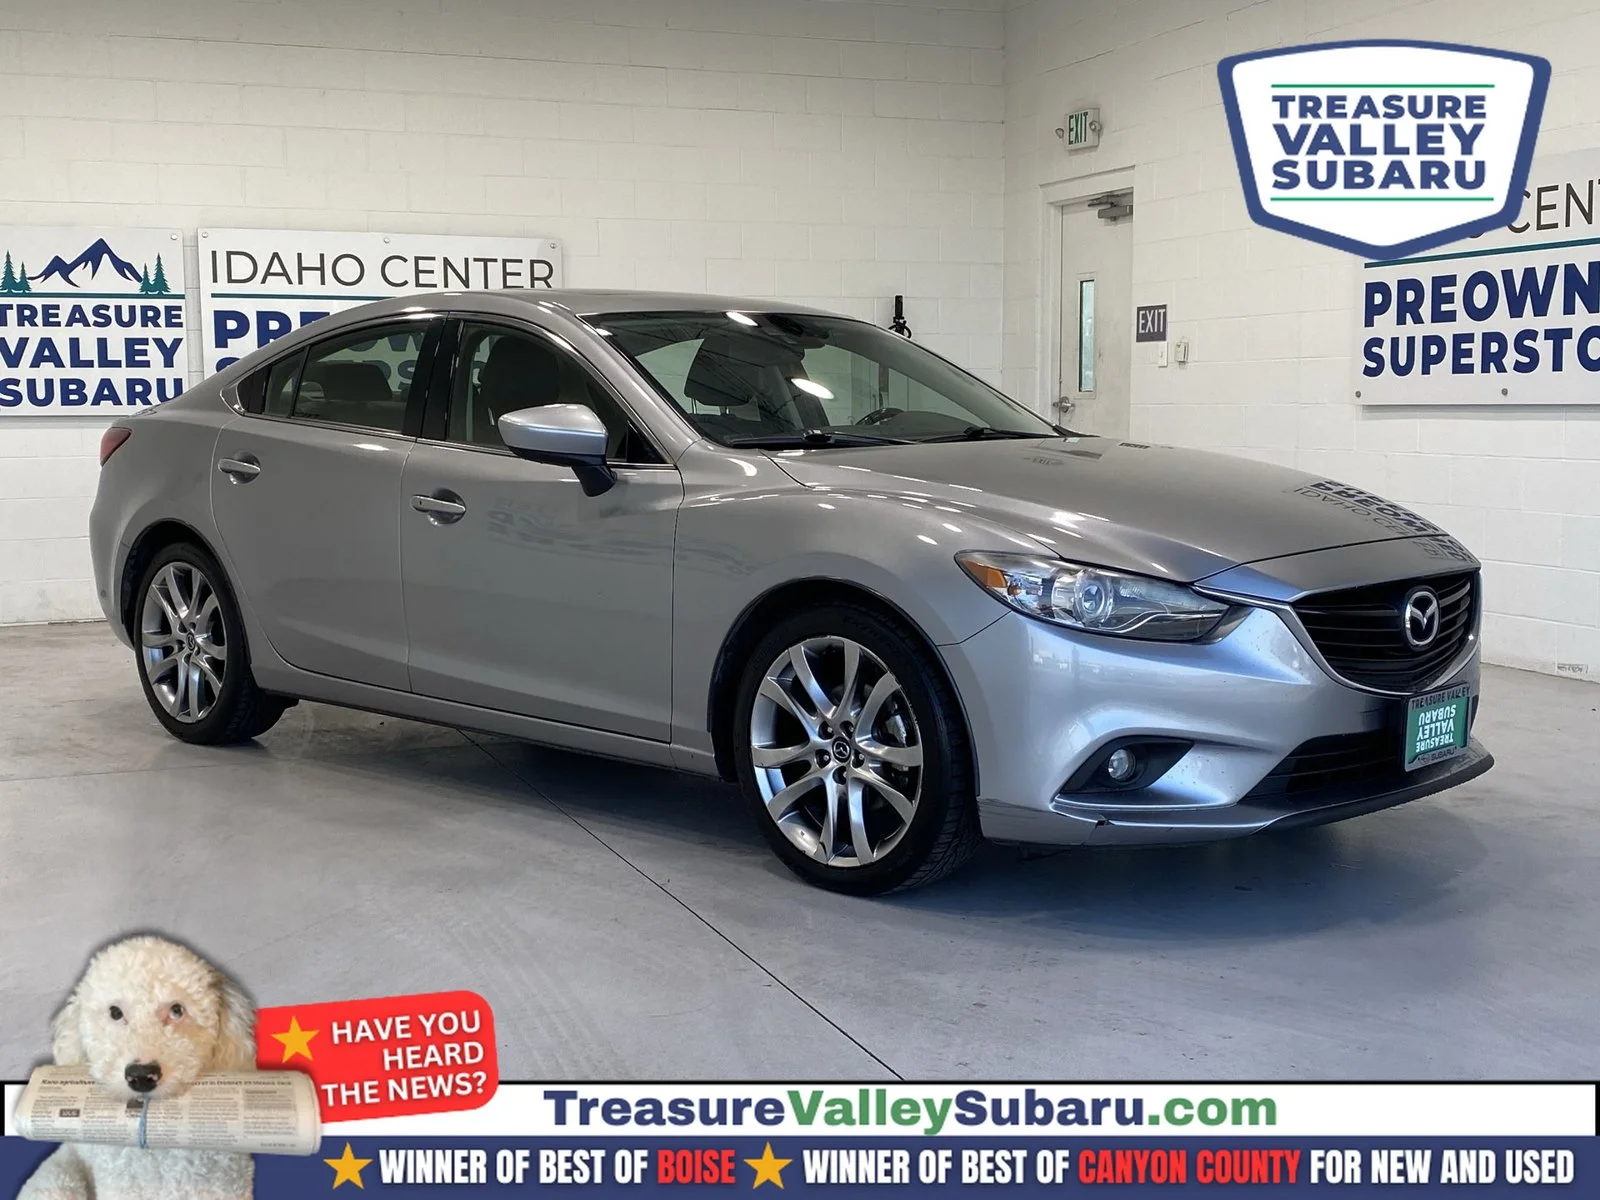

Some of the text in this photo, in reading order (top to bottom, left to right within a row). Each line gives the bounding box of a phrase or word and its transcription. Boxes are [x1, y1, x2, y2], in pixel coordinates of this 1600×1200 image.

[1068, 111, 1088, 145] EXIT
[211, 250, 554, 289] IDAHO CENTER
[1364, 260, 1600, 328] PREOWN
[0, 304, 183, 328] TREASURE
[1138, 308, 1165, 334] EXIT
[0, 337, 184, 368] VALLEY
[1362, 325, 1600, 378] SUPERSTO
[0, 378, 183, 407] SUBARU
[1411, 692, 1445, 709] TREASURE
[1418, 705, 1457, 726] SUBARU
[1416, 719, 1455, 741] VALLEY
[1416, 732, 1454, 753] TREASURE
